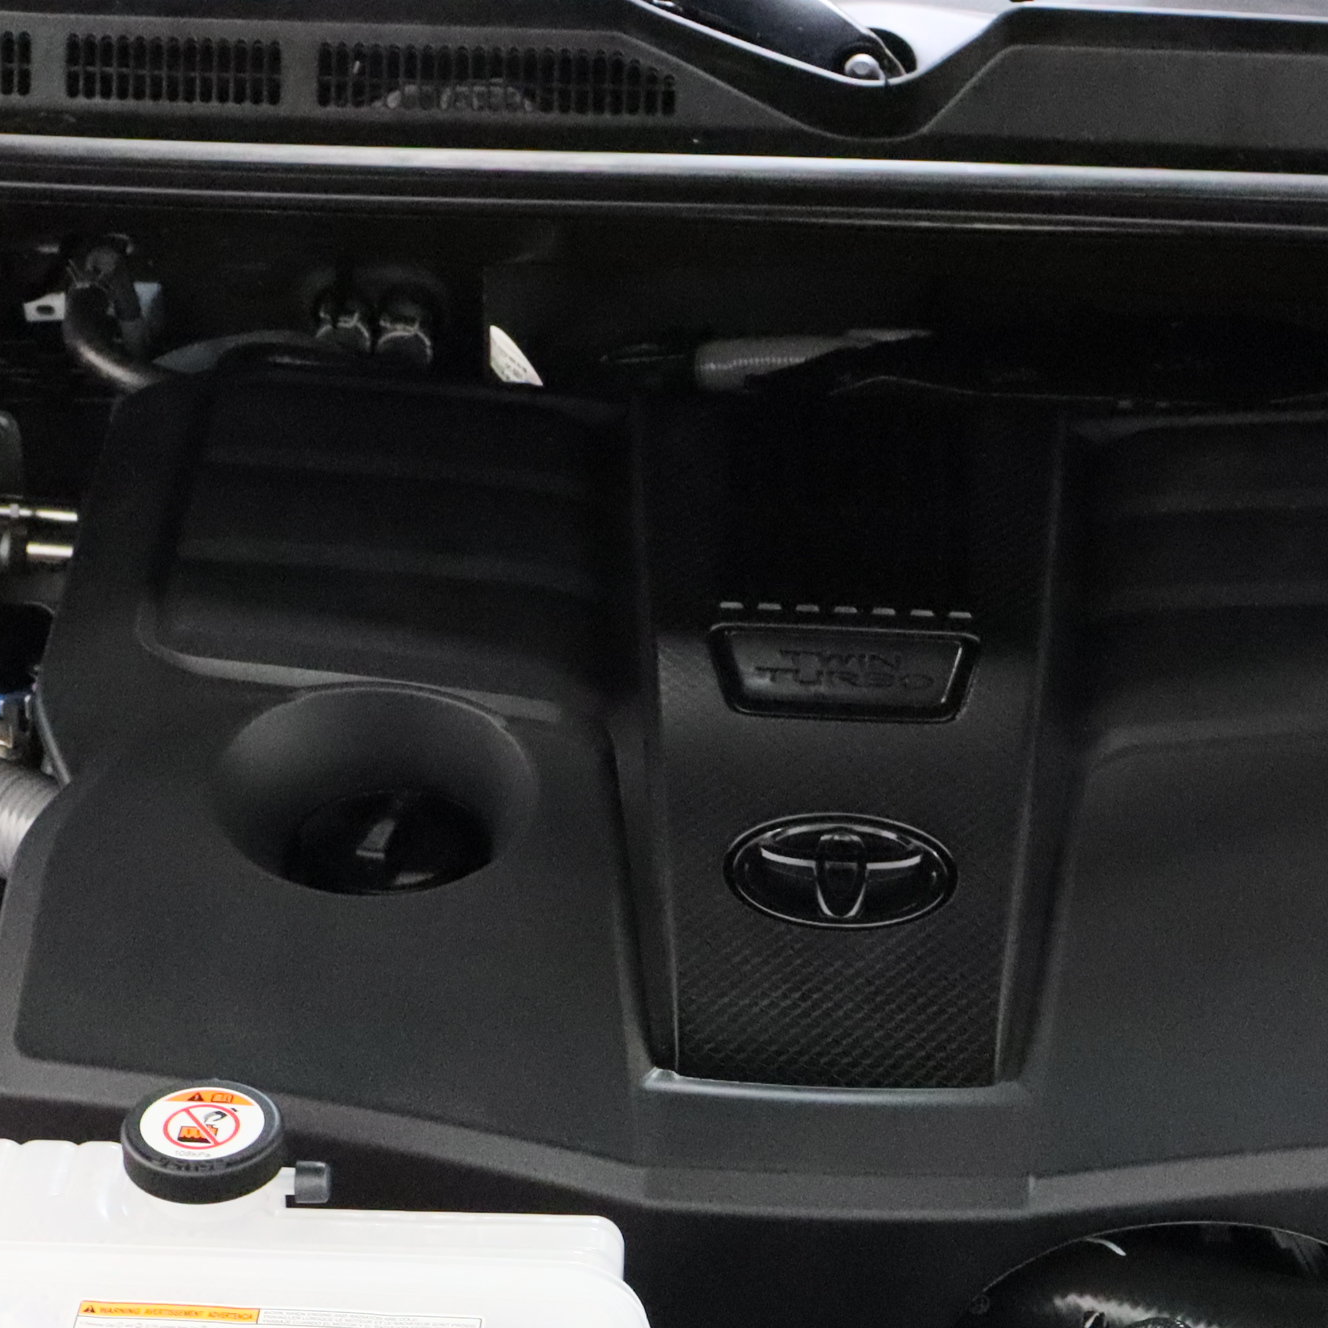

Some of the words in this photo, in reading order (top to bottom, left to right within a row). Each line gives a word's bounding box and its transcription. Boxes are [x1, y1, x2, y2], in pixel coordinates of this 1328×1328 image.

[779, 648, 903, 669] TWIN
[754, 667, 936, 690] TURBO
[99, 1307, 141, 1315] WARNING
